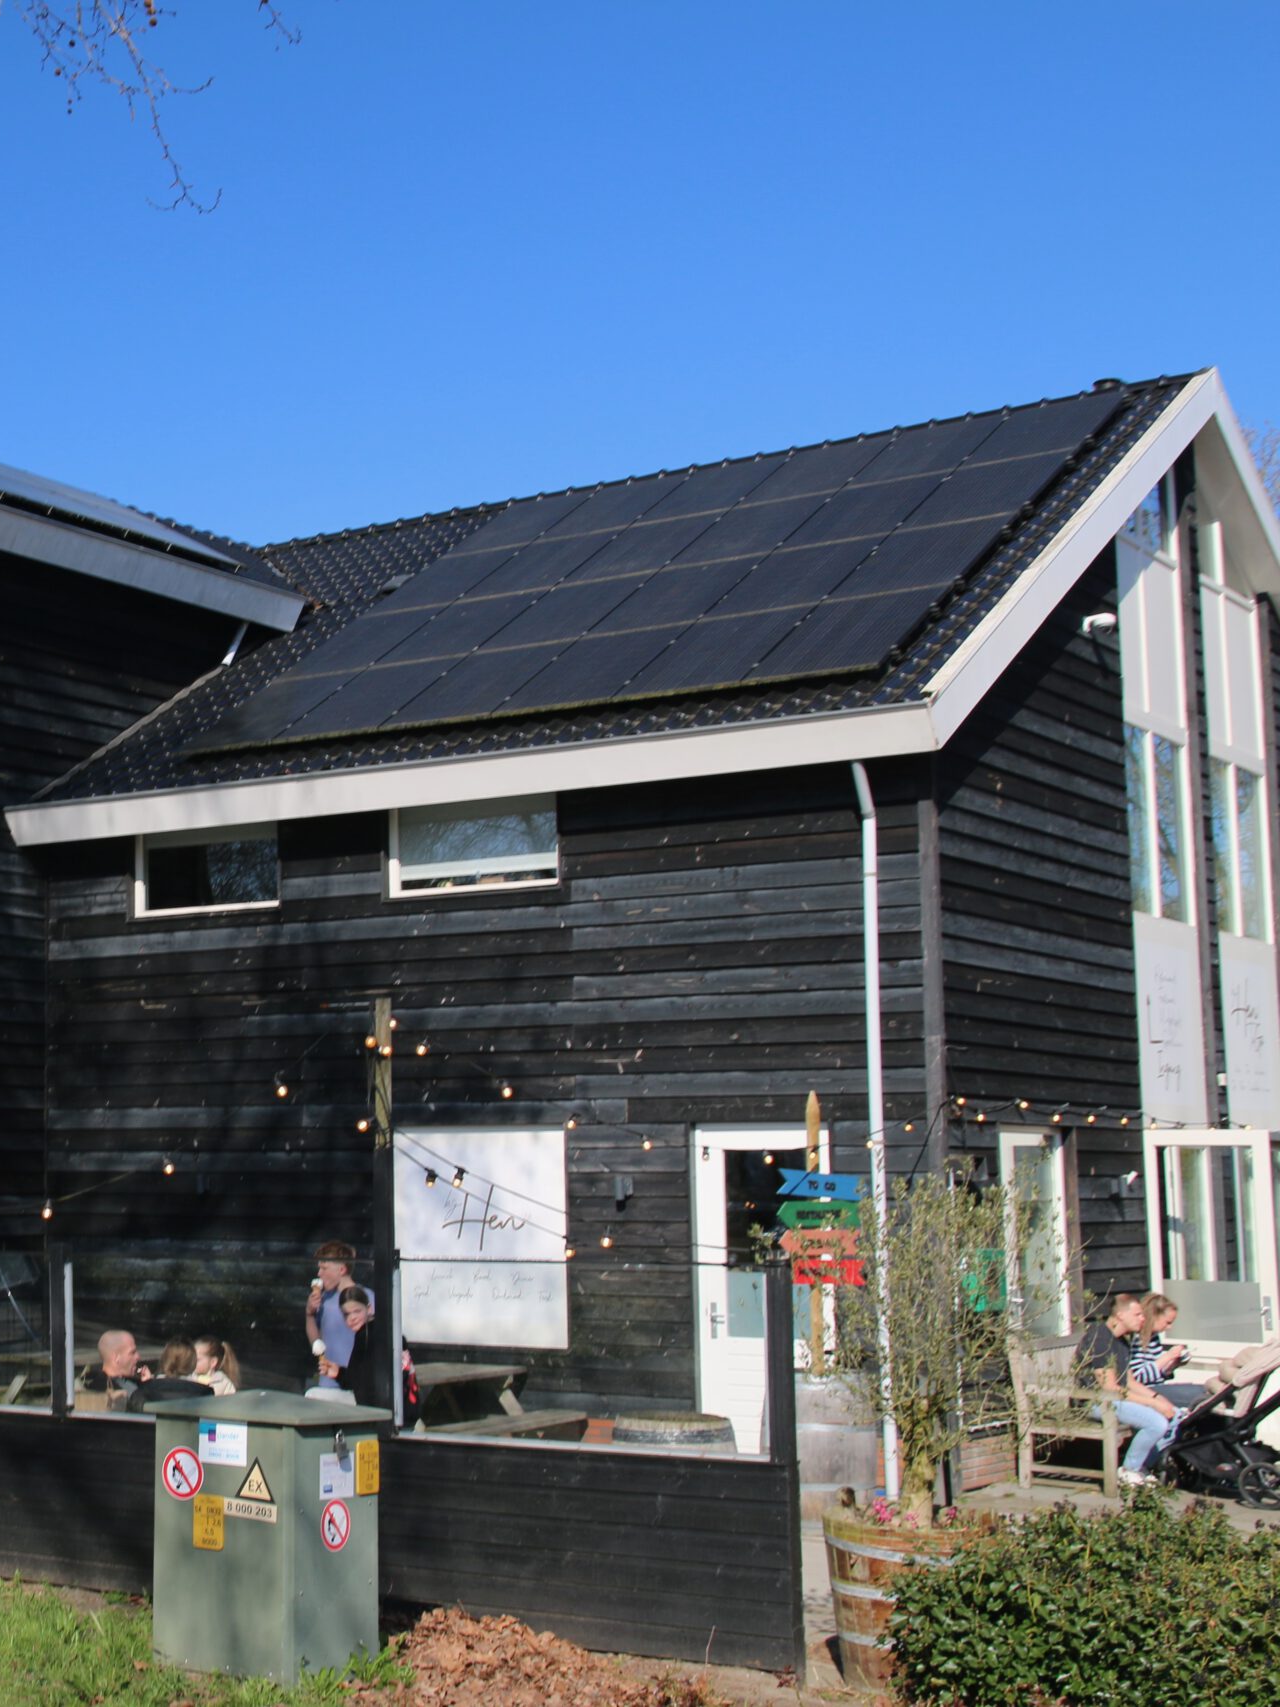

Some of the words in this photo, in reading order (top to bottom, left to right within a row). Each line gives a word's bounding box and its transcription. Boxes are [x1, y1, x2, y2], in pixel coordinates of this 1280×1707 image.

[441, 1184, 526, 1251] Hen
[248, 1480, 263, 1493] EX
[226, 1501, 233, 1511] 8
[235, 1503, 253, 1515] 000
[255, 1506, 273, 1518] 203
